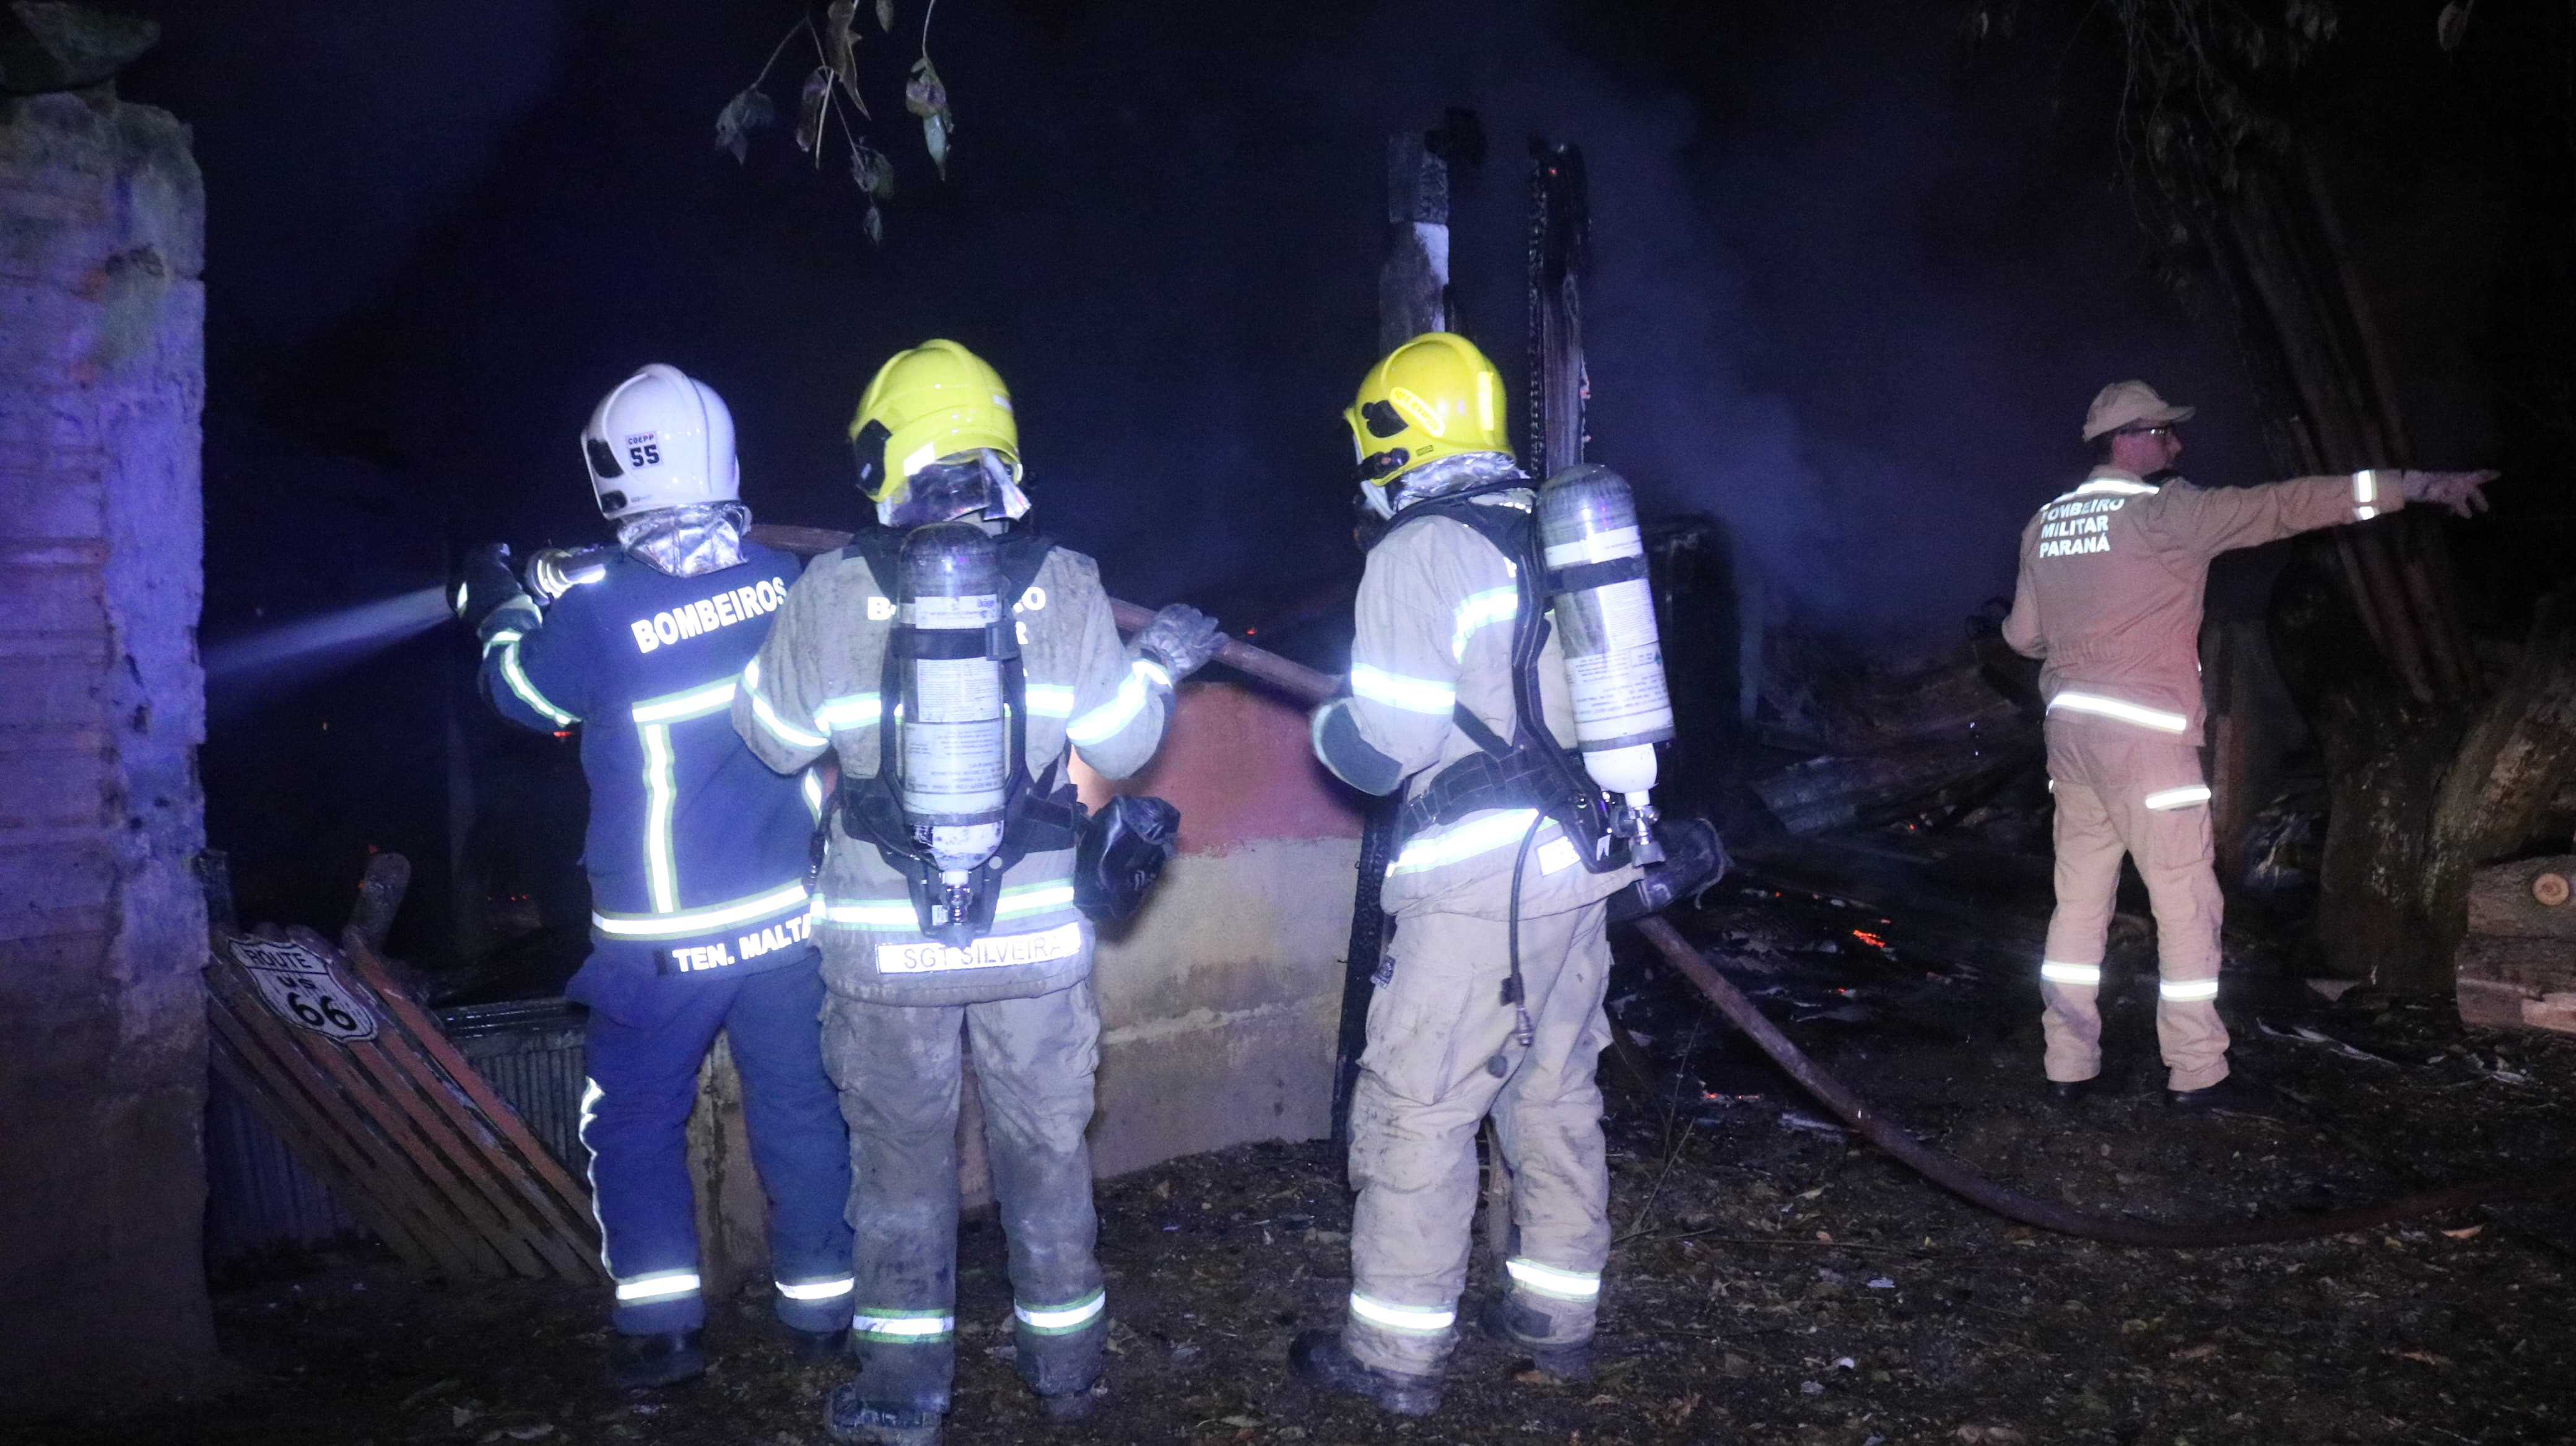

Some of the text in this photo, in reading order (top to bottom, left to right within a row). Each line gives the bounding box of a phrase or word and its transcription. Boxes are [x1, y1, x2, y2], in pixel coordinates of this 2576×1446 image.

[630, 445, 659, 466] 55
[2041, 515, 2108, 539] MILITAR
[2040, 533, 2110, 558] PARANÁ
[630, 577, 787, 654] BOMBEIROS
[246, 949, 312, 968] ROUTE
[672, 943, 735, 972] TEN.
[904, 937, 1062, 969] SGT SILVEIRA
[278, 975, 315, 990] US
[287, 992, 357, 1031] 66
